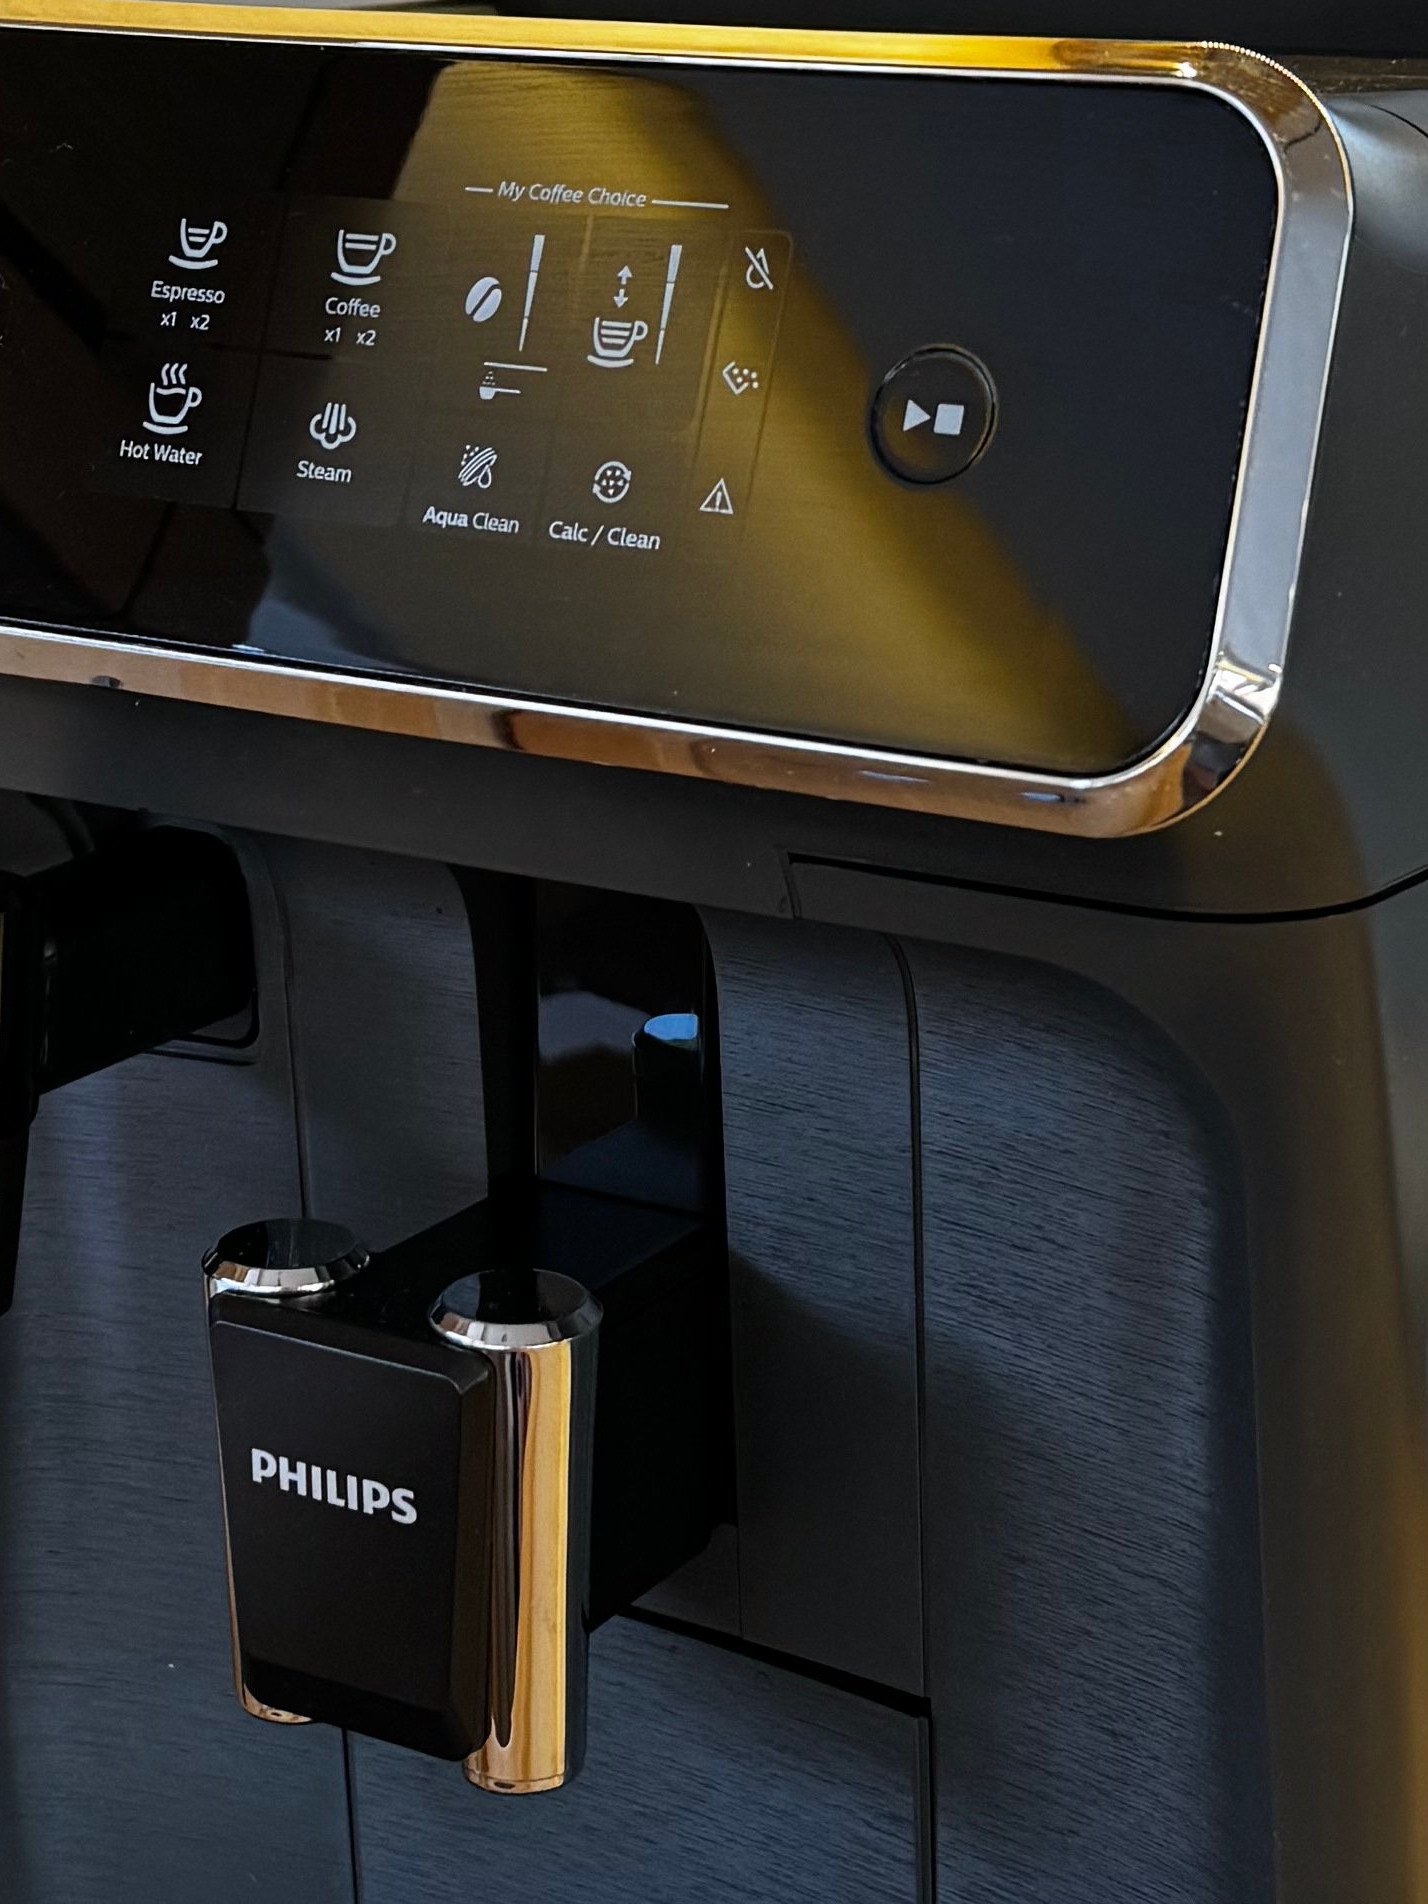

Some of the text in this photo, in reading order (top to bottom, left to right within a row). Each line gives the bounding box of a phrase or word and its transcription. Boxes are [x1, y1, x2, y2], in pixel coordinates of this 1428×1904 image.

[497, 181, 647, 208] My Coffee Choice
[150, 280, 226, 304] Espresso
[324, 297, 381, 318] Coffee
[160, 311, 211, 331] x1 x2
[323, 327, 377, 346] x1 x2
[119, 439, 203, 465] Hot Water
[296, 460, 352, 483] Steam
[472, 512, 520, 534] Clean
[548, 521, 589, 543] Calc
[607, 527, 662, 550] Clean
[250, 1447, 418, 1525] PHILIPS
